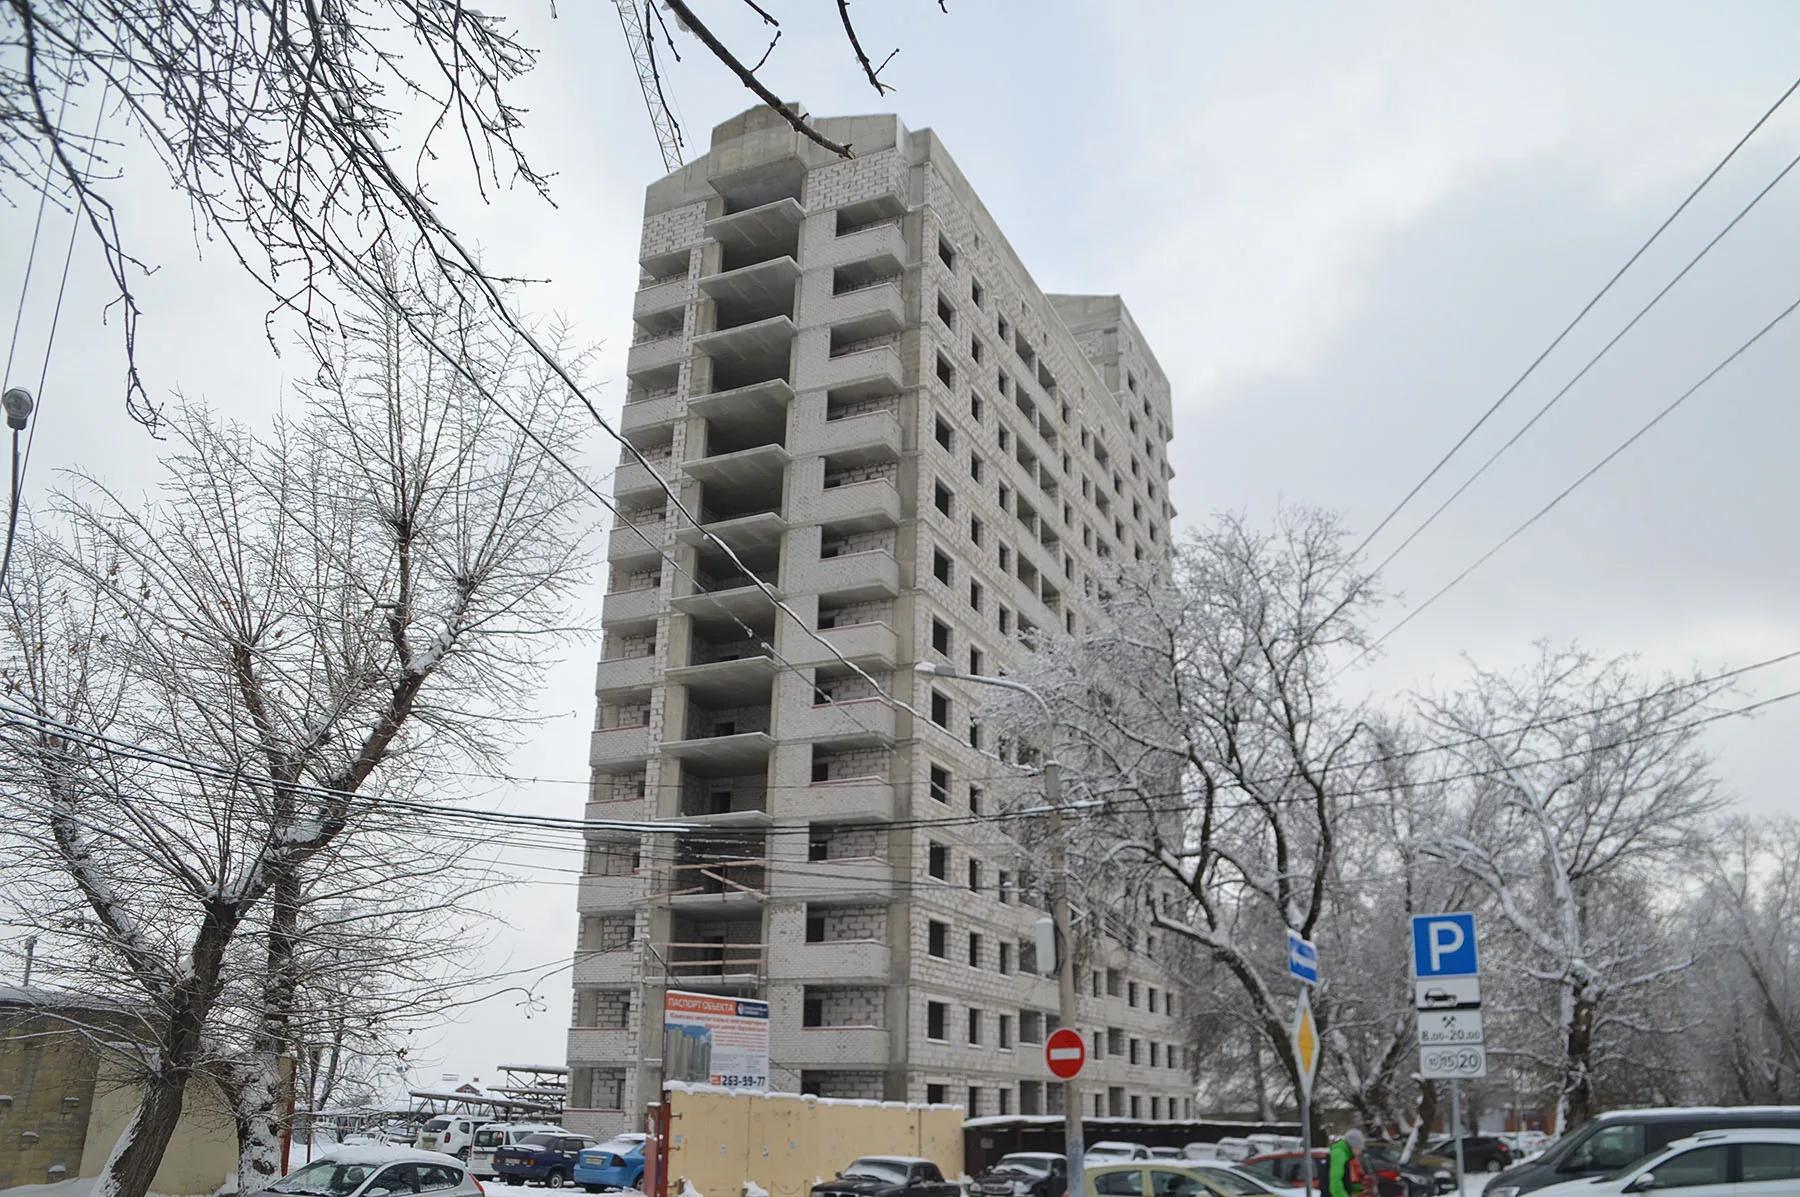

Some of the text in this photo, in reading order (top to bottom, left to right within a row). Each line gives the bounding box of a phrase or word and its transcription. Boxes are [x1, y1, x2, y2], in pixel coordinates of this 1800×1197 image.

[1428, 920, 1465, 971] P
[668, 997, 702, 1010] ПАСПОРТ
[703, 1000, 735, 1013] ОБЪЕКТА
[1440, 1055, 1455, 1067] 15
[1459, 1054, 1478, 1068] 20
[722, 1075, 766, 1087] 263-99-77
